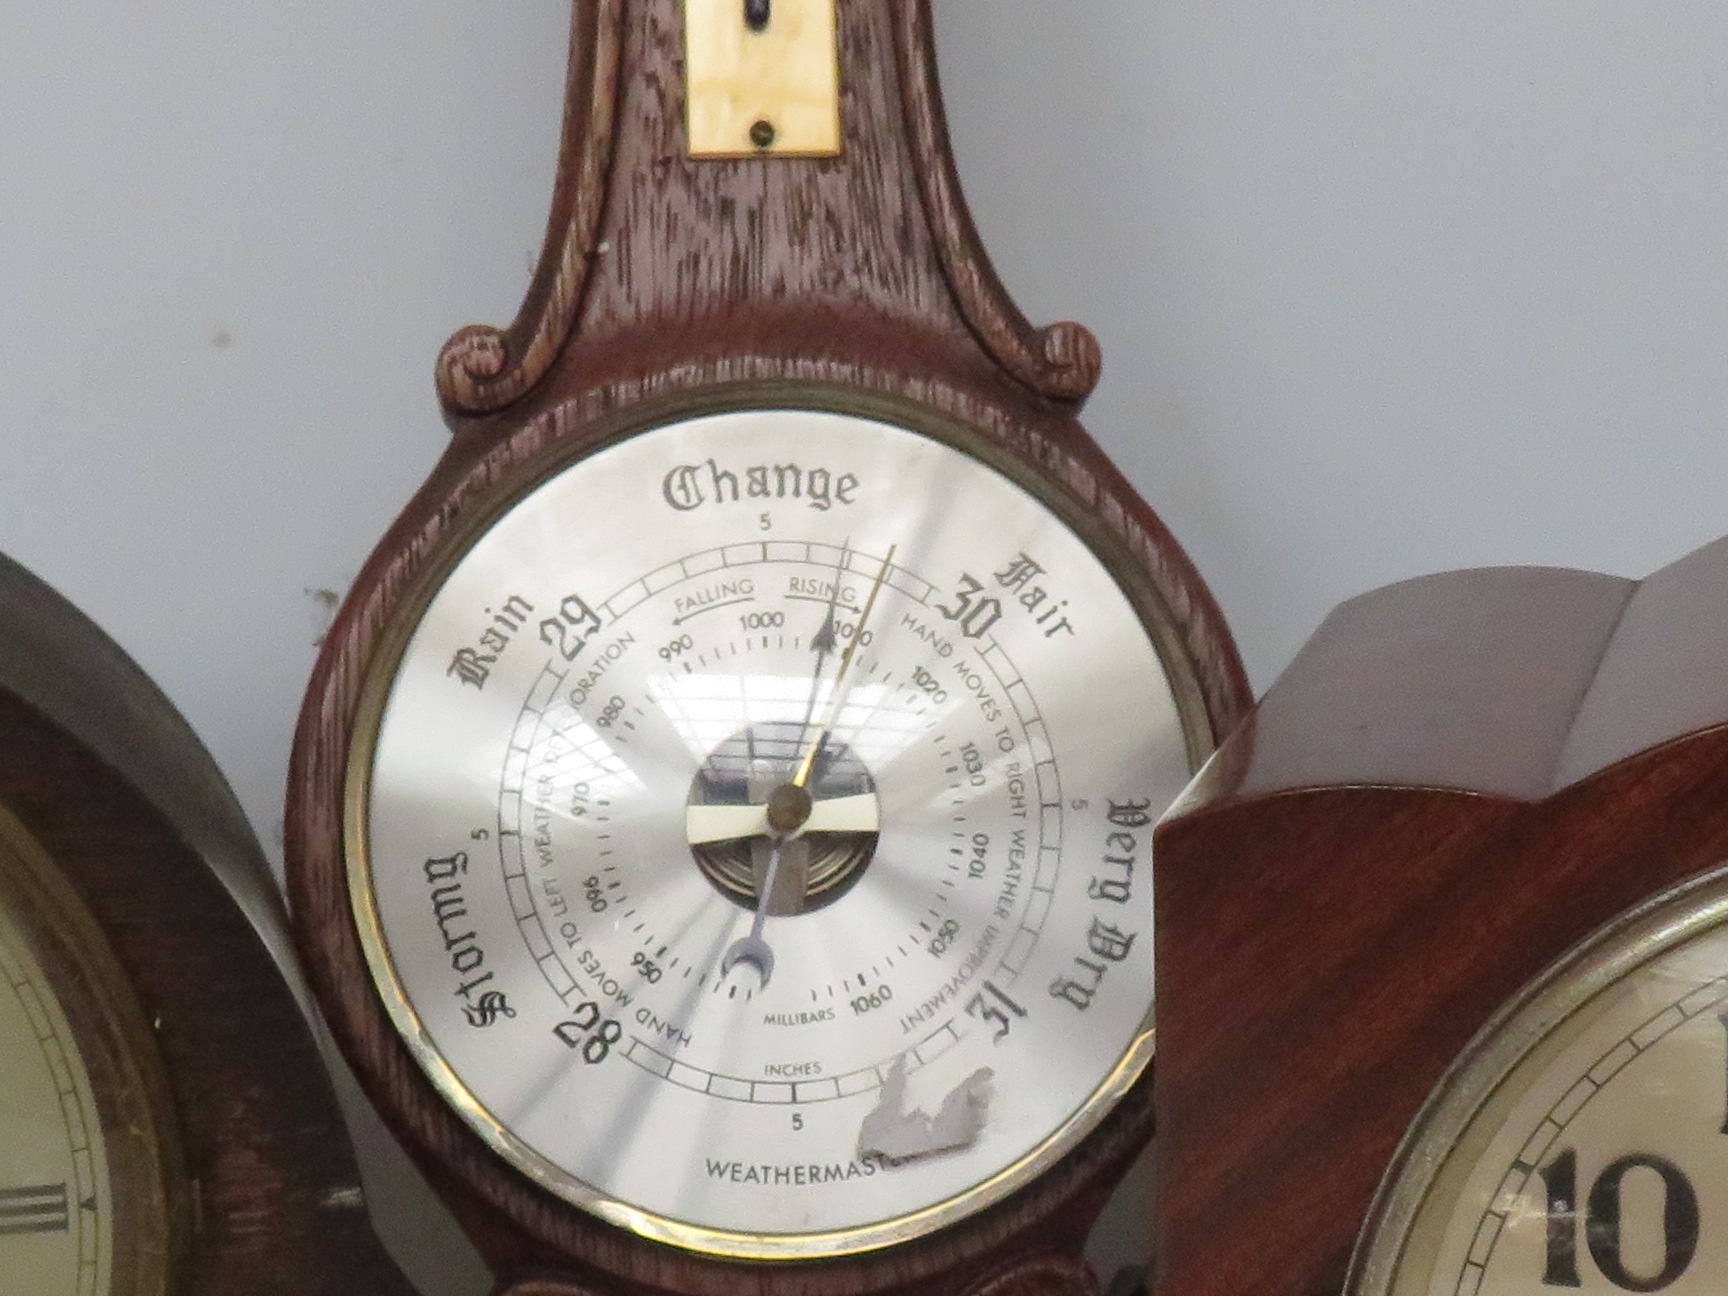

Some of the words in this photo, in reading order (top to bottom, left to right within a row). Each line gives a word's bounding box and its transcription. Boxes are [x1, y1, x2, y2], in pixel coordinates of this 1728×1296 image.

[662, 459, 861, 511] Change
[759, 513, 773, 532] 5
[673, 578, 755, 614] FALLING
[788, 576, 858, 603] RISING
[934, 572, 1003, 640] 30
[993, 550, 1076, 638] Fair
[539, 592, 603, 663] 29
[738, 610, 786, 632] 1000
[833, 619, 874, 648] 100
[900, 612, 954, 659] HAND
[446, 594, 535, 692] Rain
[658, 633, 694, 663] 990
[910, 664, 949, 706] 1020
[953, 660, 1002, 723] MOVES
[595, 695, 626, 730] 980
[994, 725, 1016, 754] TO
[959, 741, 987, 788] 1030
[570, 781, 591, 817] 970
[1005, 761, 1028, 820] RIGHT
[470, 827, 490, 841] 5
[533, 774, 556, 868] WEATHER
[967, 832, 991, 880] 1040
[1087, 796, 1152, 905] Very
[582, 875, 608, 913] 960
[993, 828, 1027, 920] WEATHER
[542, 877, 568, 918] LEFT
[423, 851, 518, 1029] Stormy
[560, 921, 583, 950] TO
[927, 918, 962, 960] 1050
[577, 949, 635, 1009] MOVES
[630, 951, 663, 985] 950
[899, 923, 1001, 1036] IMPROVEMENT
[1048, 913, 1139, 1012] Dry
[762, 1007, 837, 1027] MILLIBARS
[849, 983, 894, 1017] 1060
[964, 978, 1029, 1047] 31
[552, 1001, 623, 1065] 28
[635, 1007, 694, 1049] HAND
[763, 1060, 823, 1077] INCHES
[791, 1112, 804, 1131] 5
[1540, 1143, 1701, 1294] 10
